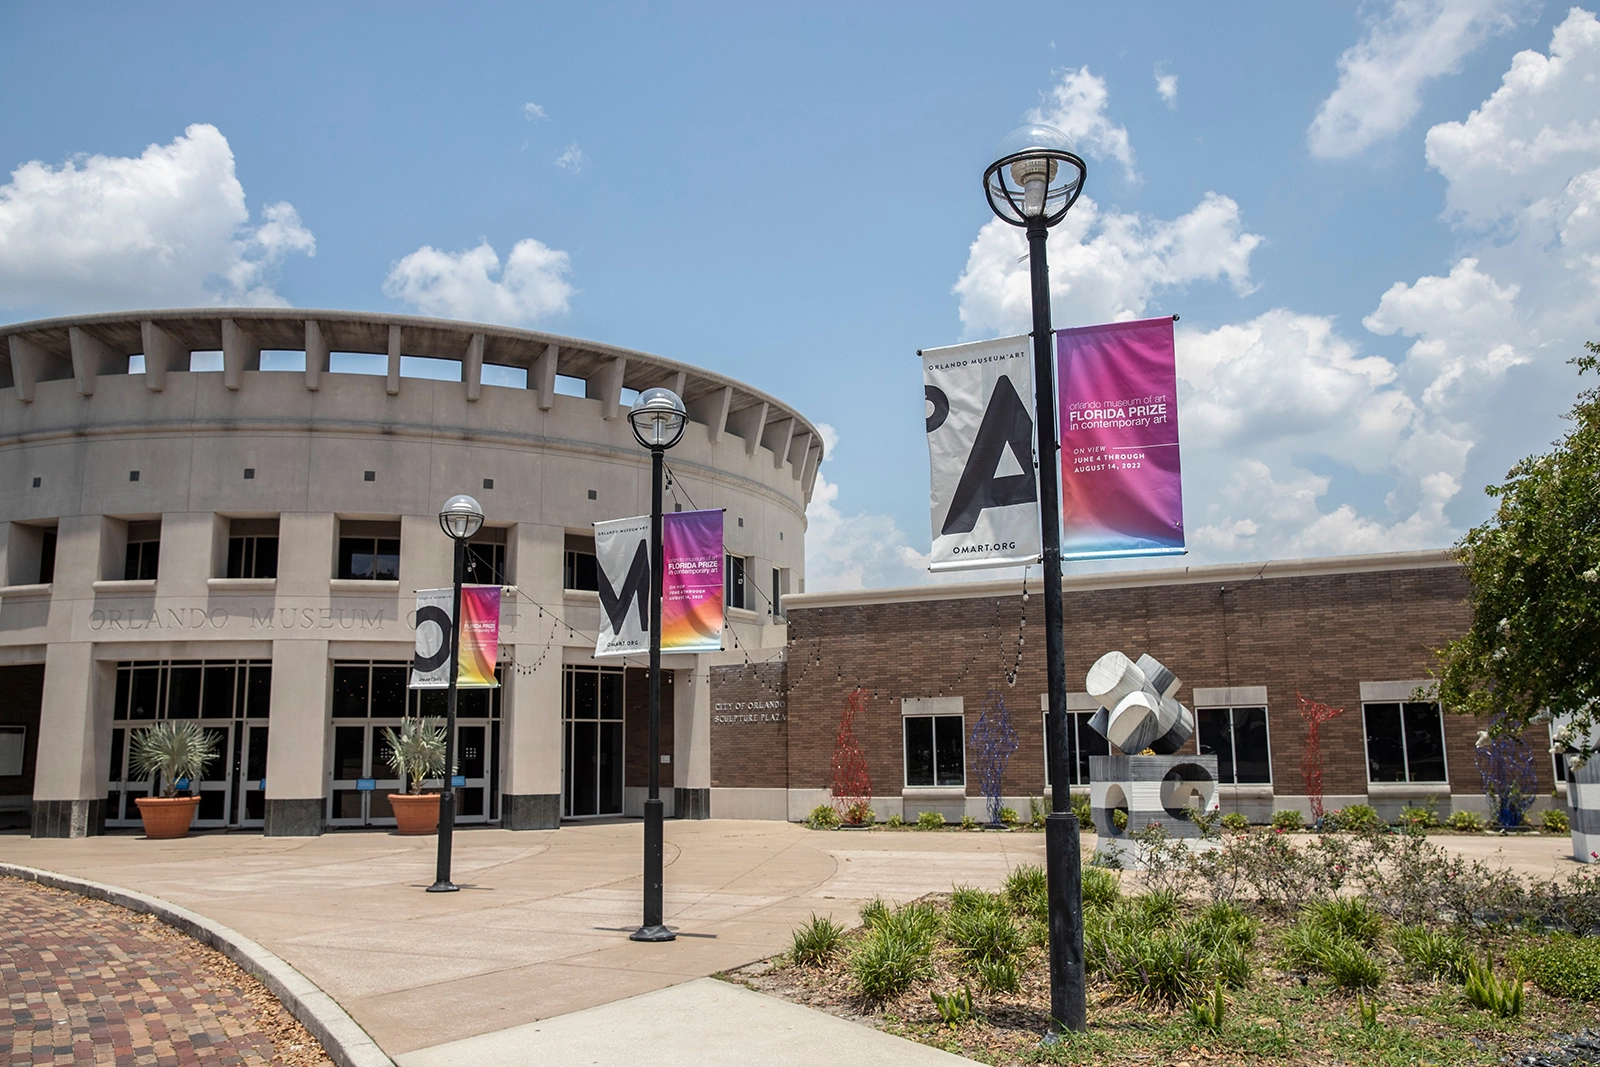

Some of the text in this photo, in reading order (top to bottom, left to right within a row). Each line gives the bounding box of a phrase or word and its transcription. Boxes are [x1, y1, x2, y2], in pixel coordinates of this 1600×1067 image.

[929, 361, 967, 370] ORLANDO
[971, 355, 1005, 365] MUSEUM
[1069, 394, 1166, 410] orlando museum of art
[1069, 404, 1166, 421] FLORIDA PRIZE
[1070, 414, 1167, 431] in contemporary art
[1073, 456, 1094, 464] JUNE
[1074, 464, 1105, 473] AUGUST
[953, 541, 1015, 554] OMART.ORG
[668, 562, 697, 570] FLORIDA
[88, 607, 229, 631] ORLANDO
[250, 607, 385, 630] MUSEUM
[715, 701, 786, 711] CITY OF ORLANDO
[714, 713, 787, 723] SCULPTURE PLAZA
